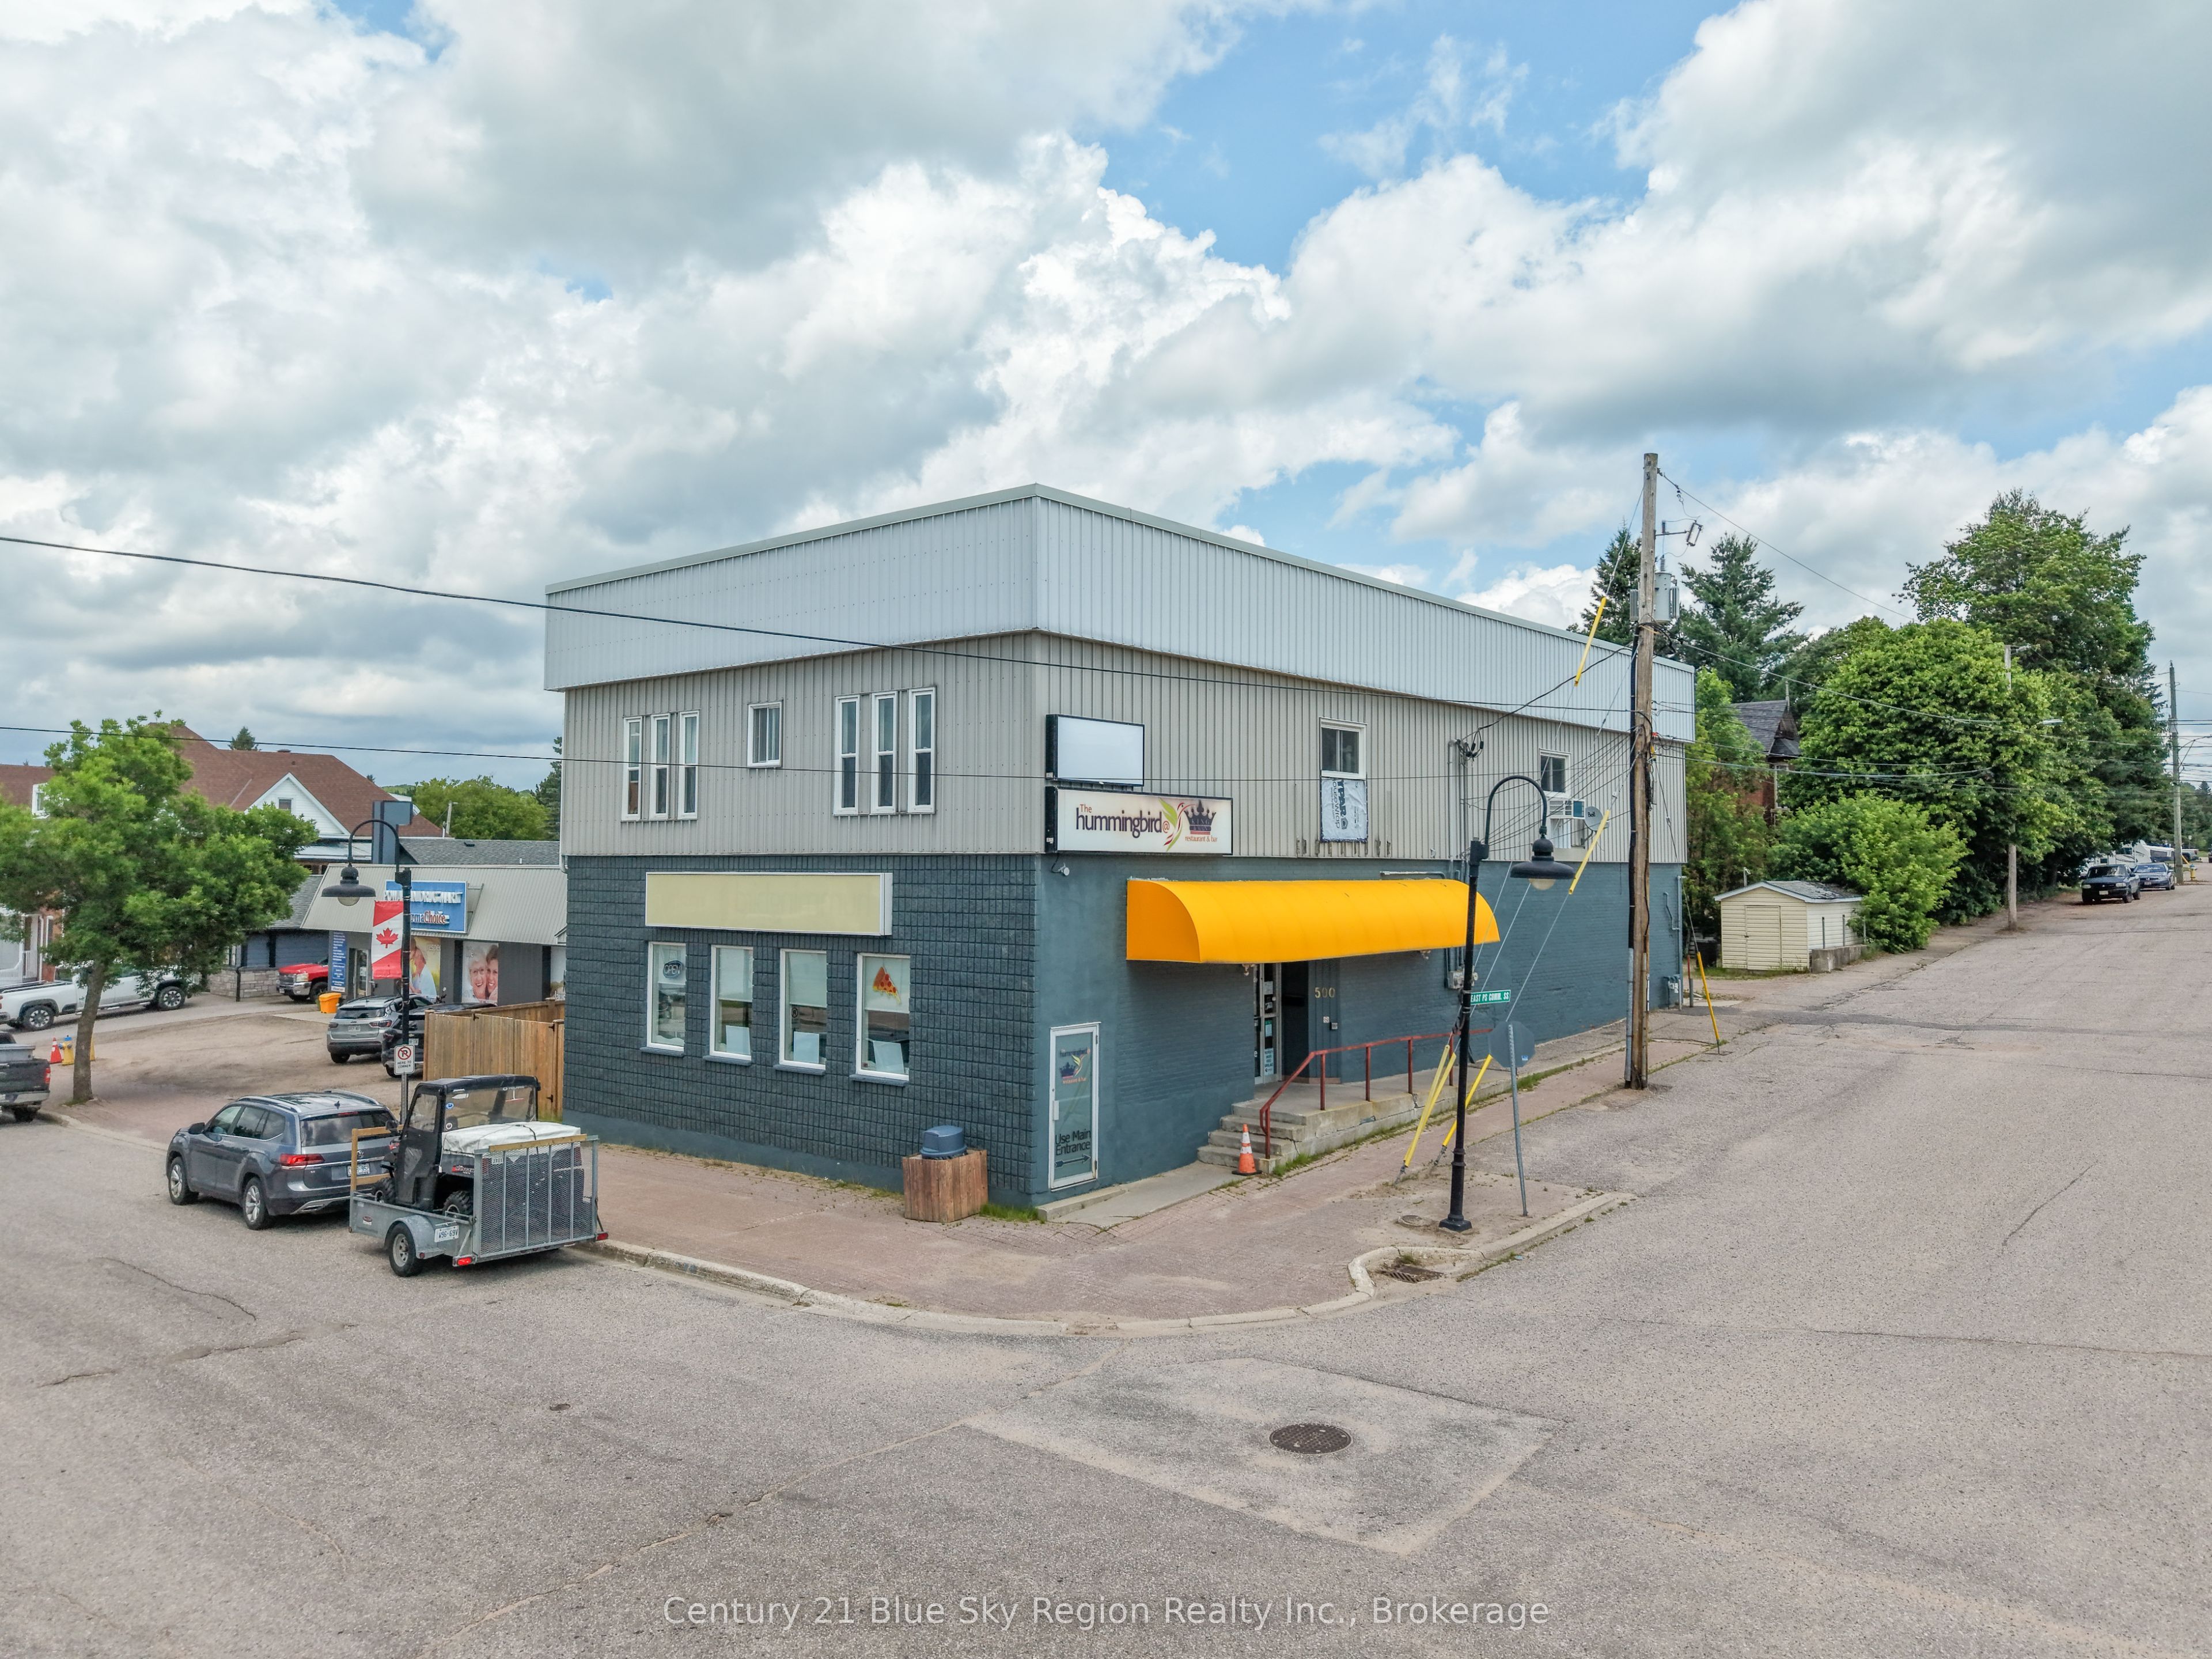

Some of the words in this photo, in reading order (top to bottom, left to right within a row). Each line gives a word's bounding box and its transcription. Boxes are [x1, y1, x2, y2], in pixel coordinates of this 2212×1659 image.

[1080, 804, 1092, 813] The
[1075, 807, 1162, 838] hummingbird
[664, 965, 681, 974] OPEN
[1315, 987, 1336, 998] 500
[1055, 1134, 1070, 1145] Use
[1073, 1128, 1091, 1141] Main
[1056, 1141, 1090, 1156] Entrance
